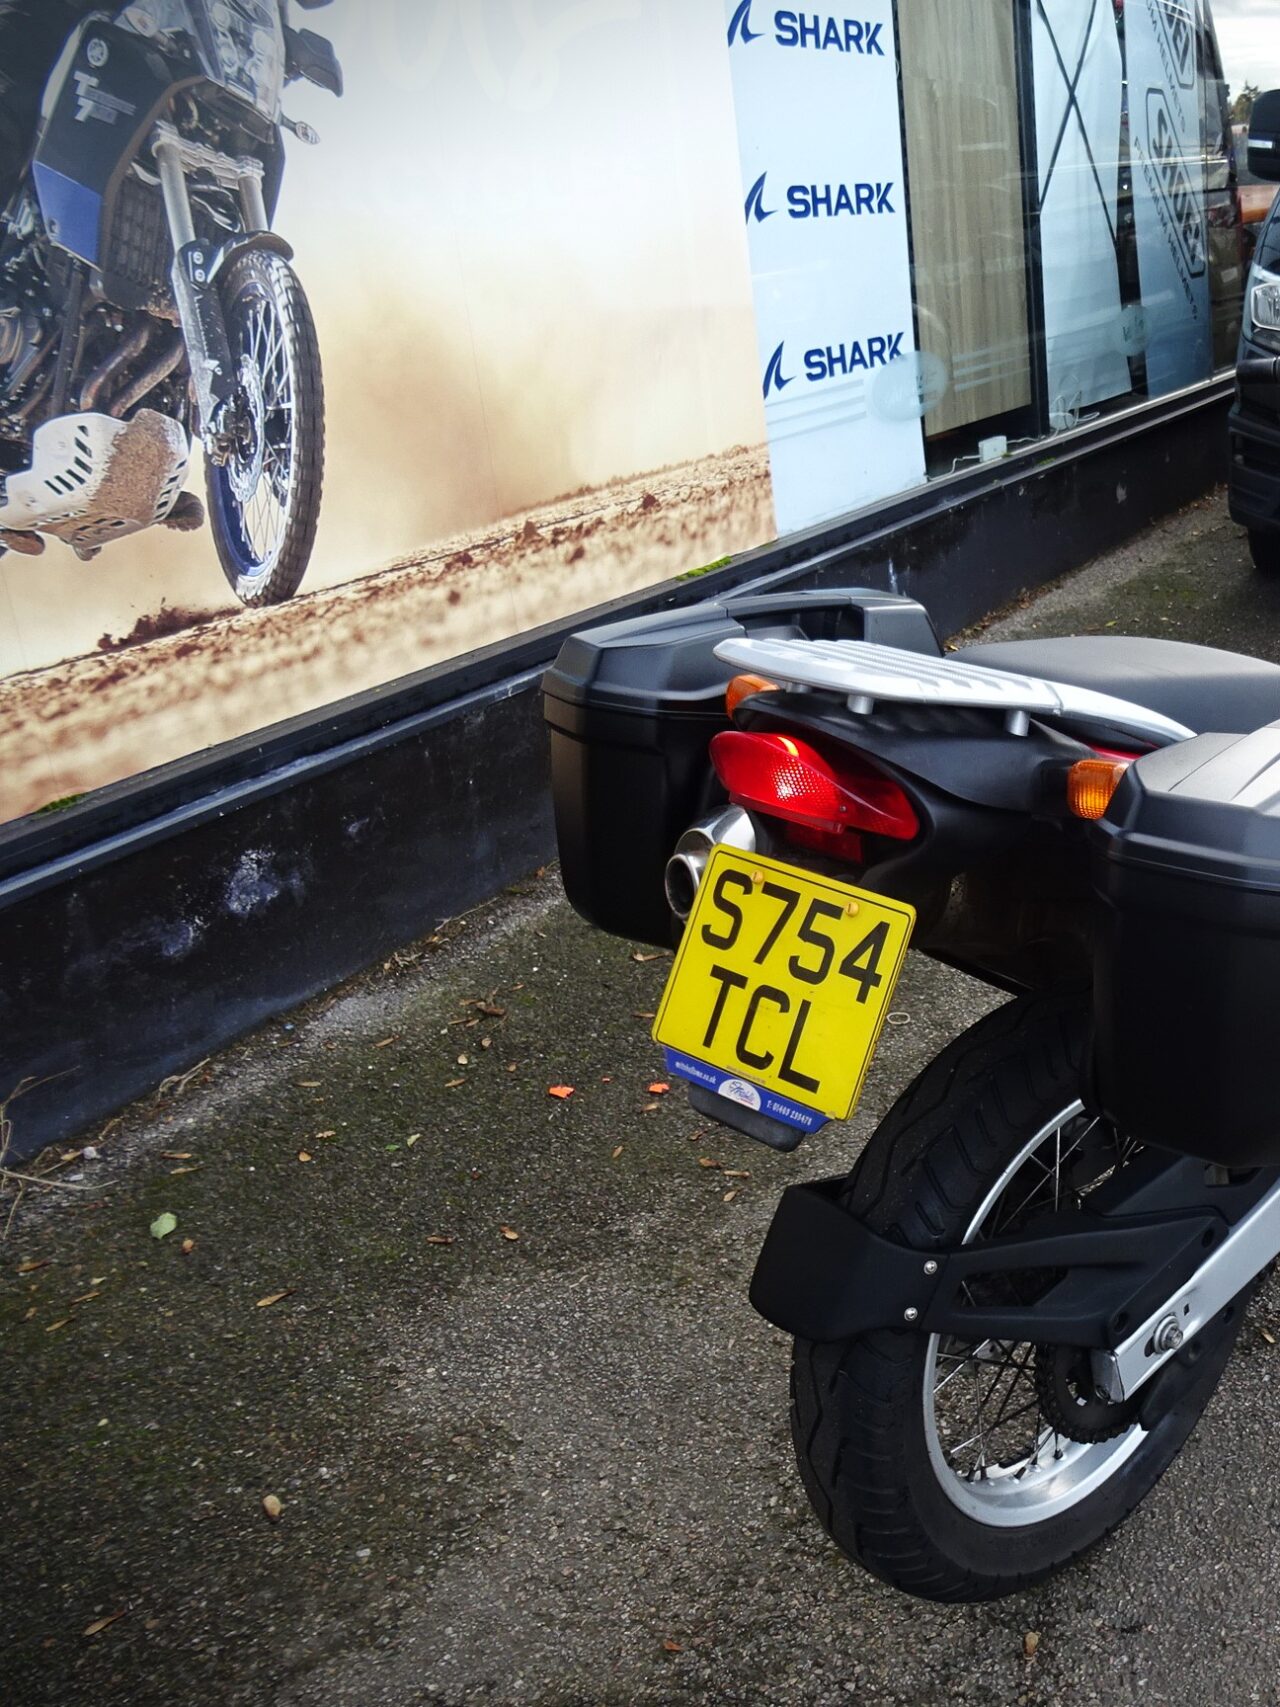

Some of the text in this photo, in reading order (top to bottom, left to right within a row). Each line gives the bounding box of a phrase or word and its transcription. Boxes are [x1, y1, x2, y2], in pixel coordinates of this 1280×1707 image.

[774, 10, 885, 56] SHARK
[786, 182, 896, 218] SHARK
[803, 332, 904, 382] SHARK
[701, 869, 890, 1004] S754
[702, 964, 820, 1094] TCL
